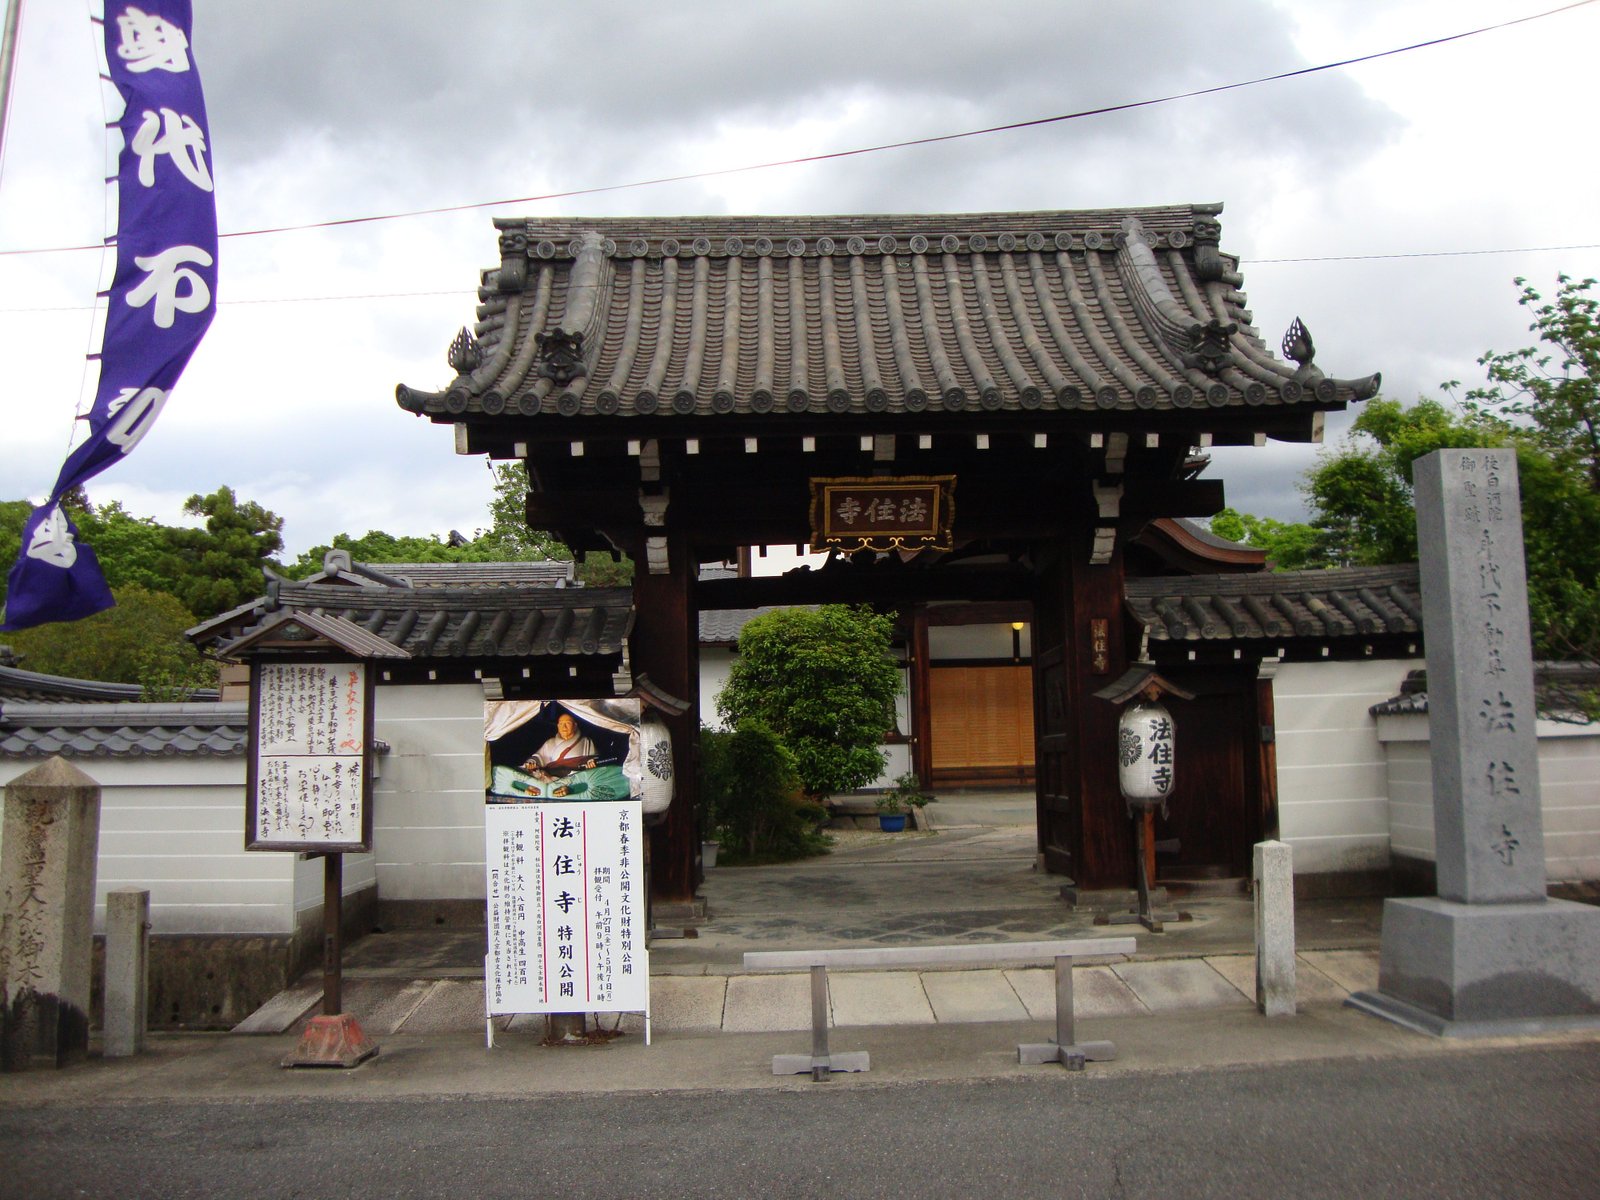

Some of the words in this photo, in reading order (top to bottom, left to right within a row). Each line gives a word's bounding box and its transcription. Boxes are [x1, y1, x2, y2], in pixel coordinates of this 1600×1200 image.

[836, 497, 928, 525] 法住寺
[1148, 717, 1174, 794] 法住寺
[1479, 690, 1521, 867] 法住寺
[515, 829, 526, 866] 拝観料
[516, 874, 526, 892] 大人
[594, 866, 603, 903] 拝観受付
[601, 866, 611, 885] 期間
[618, 809, 633, 975] 京都春季非公開文化財特別公開
[516, 894, 527, 922] 八百円
[517, 929, 527, 957] 中高生
[518, 960, 529, 986] 四百円
